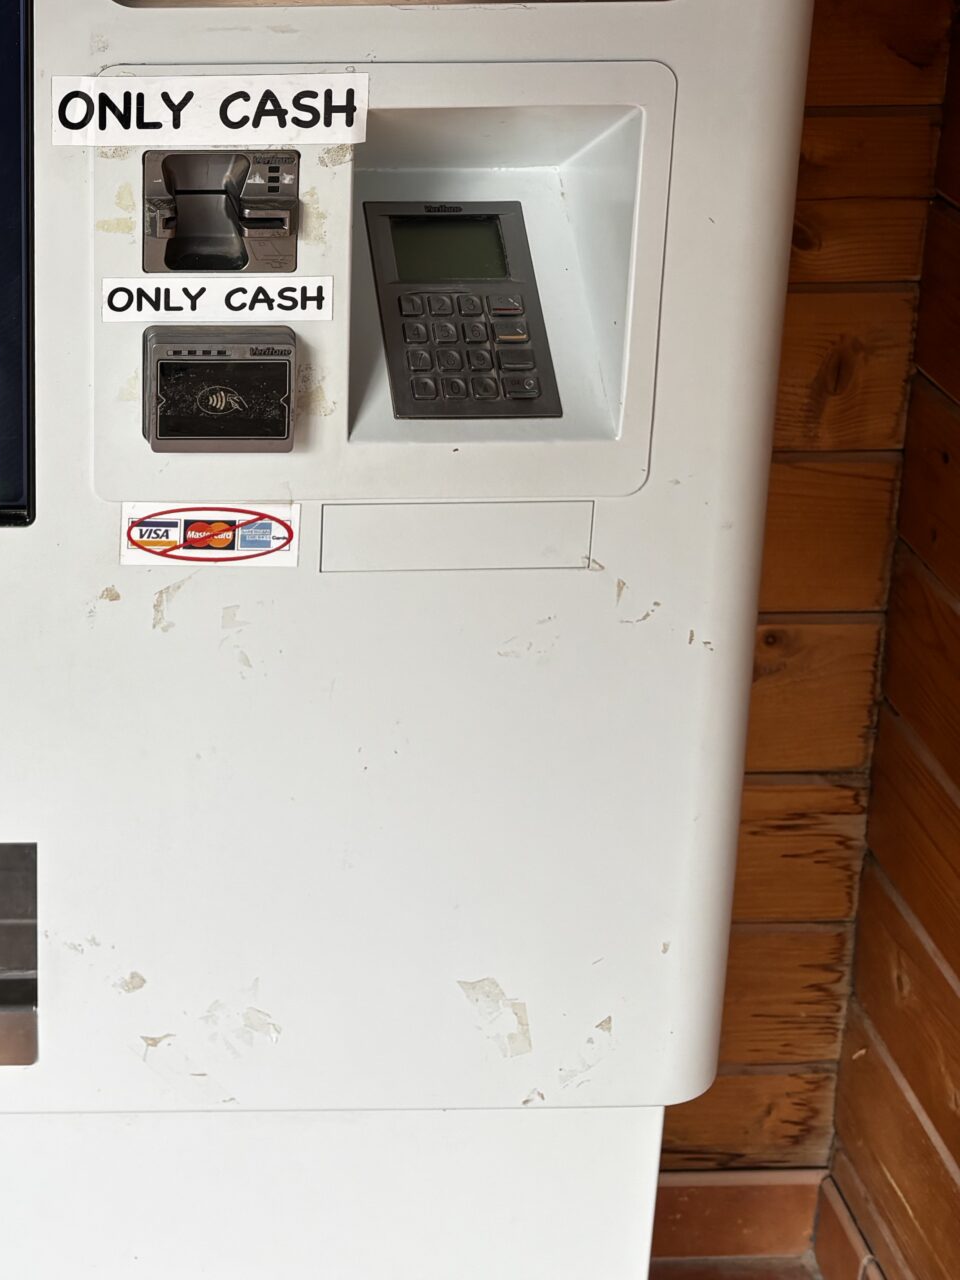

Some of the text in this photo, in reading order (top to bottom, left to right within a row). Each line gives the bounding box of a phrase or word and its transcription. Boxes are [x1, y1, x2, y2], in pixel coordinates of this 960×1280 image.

[58, 88, 357, 130] ONLY CASH
[107, 286, 325, 312] ONLY CASH
[249, 346, 292, 357] Verifone
[138, 528, 170, 540] VISA
[186, 531, 233, 540] MasteCard
